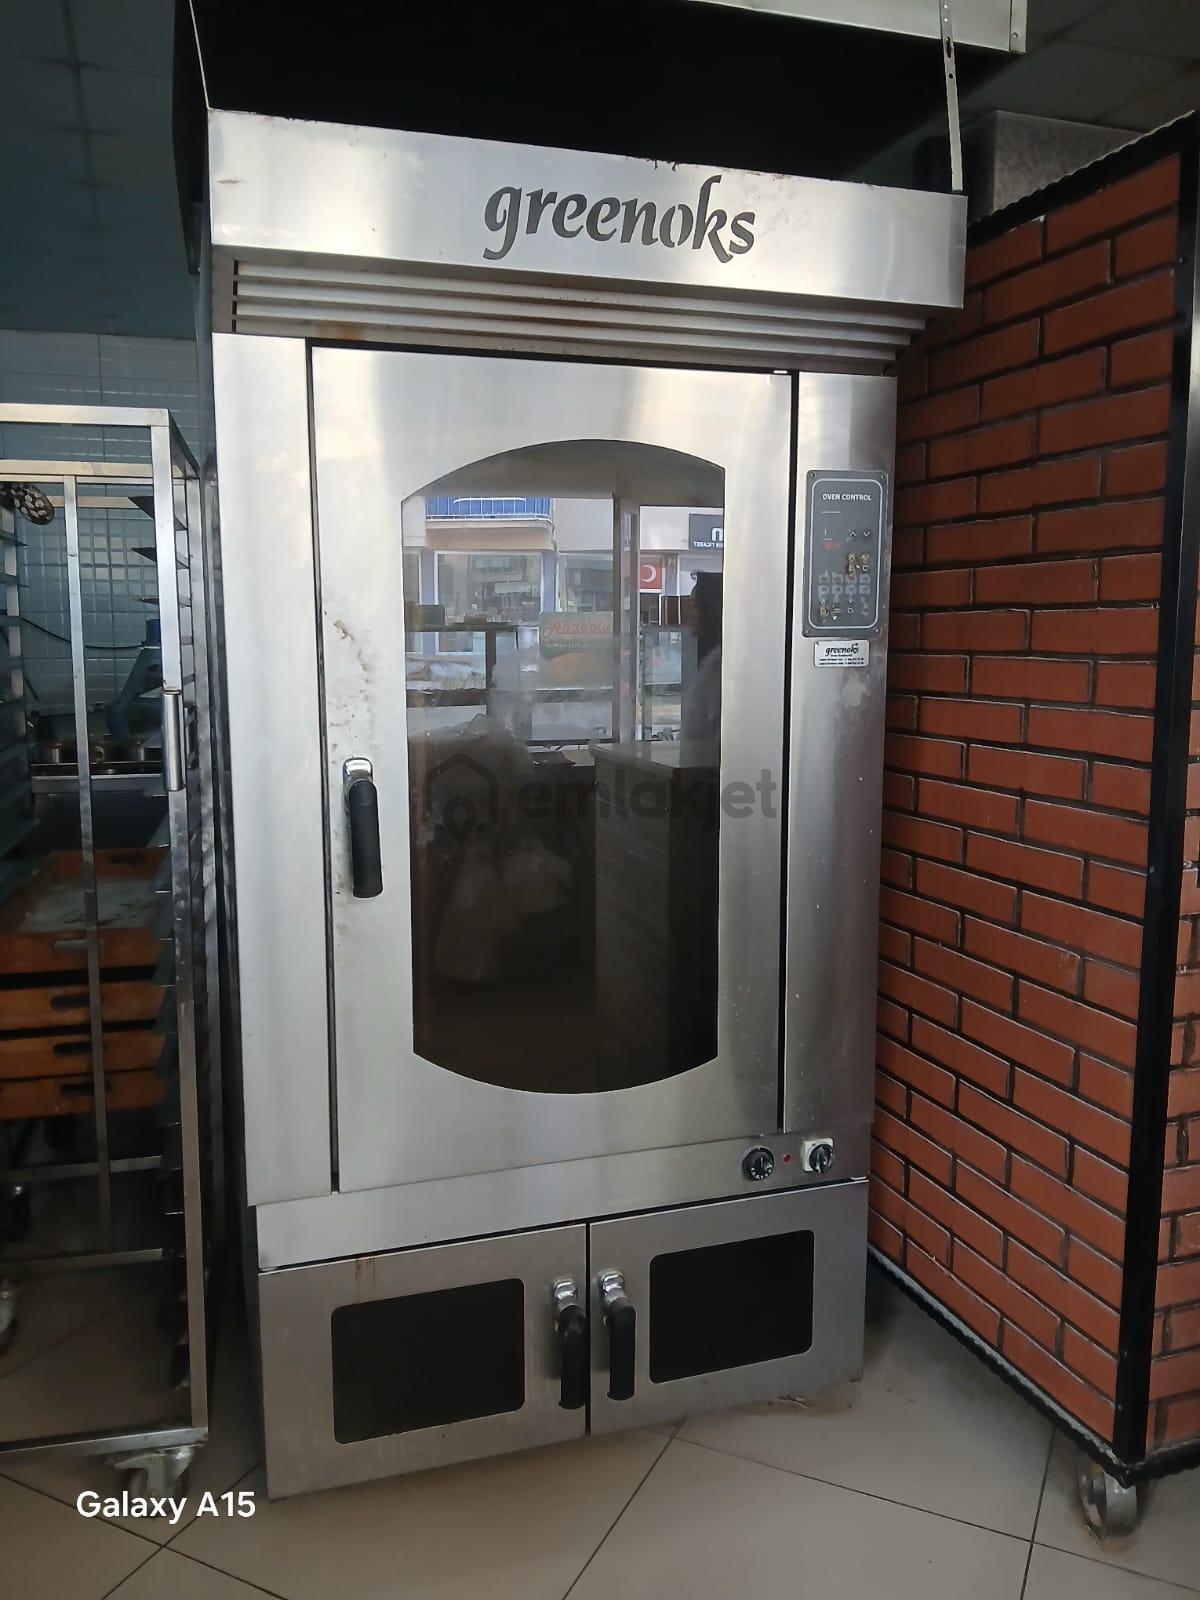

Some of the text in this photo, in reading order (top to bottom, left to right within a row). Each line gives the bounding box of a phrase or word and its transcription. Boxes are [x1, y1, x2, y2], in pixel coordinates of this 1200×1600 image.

[483, 174, 756, 264] greenoks
[822, 493, 840, 501] OVEN
[825, 643, 859, 656] greenoks
